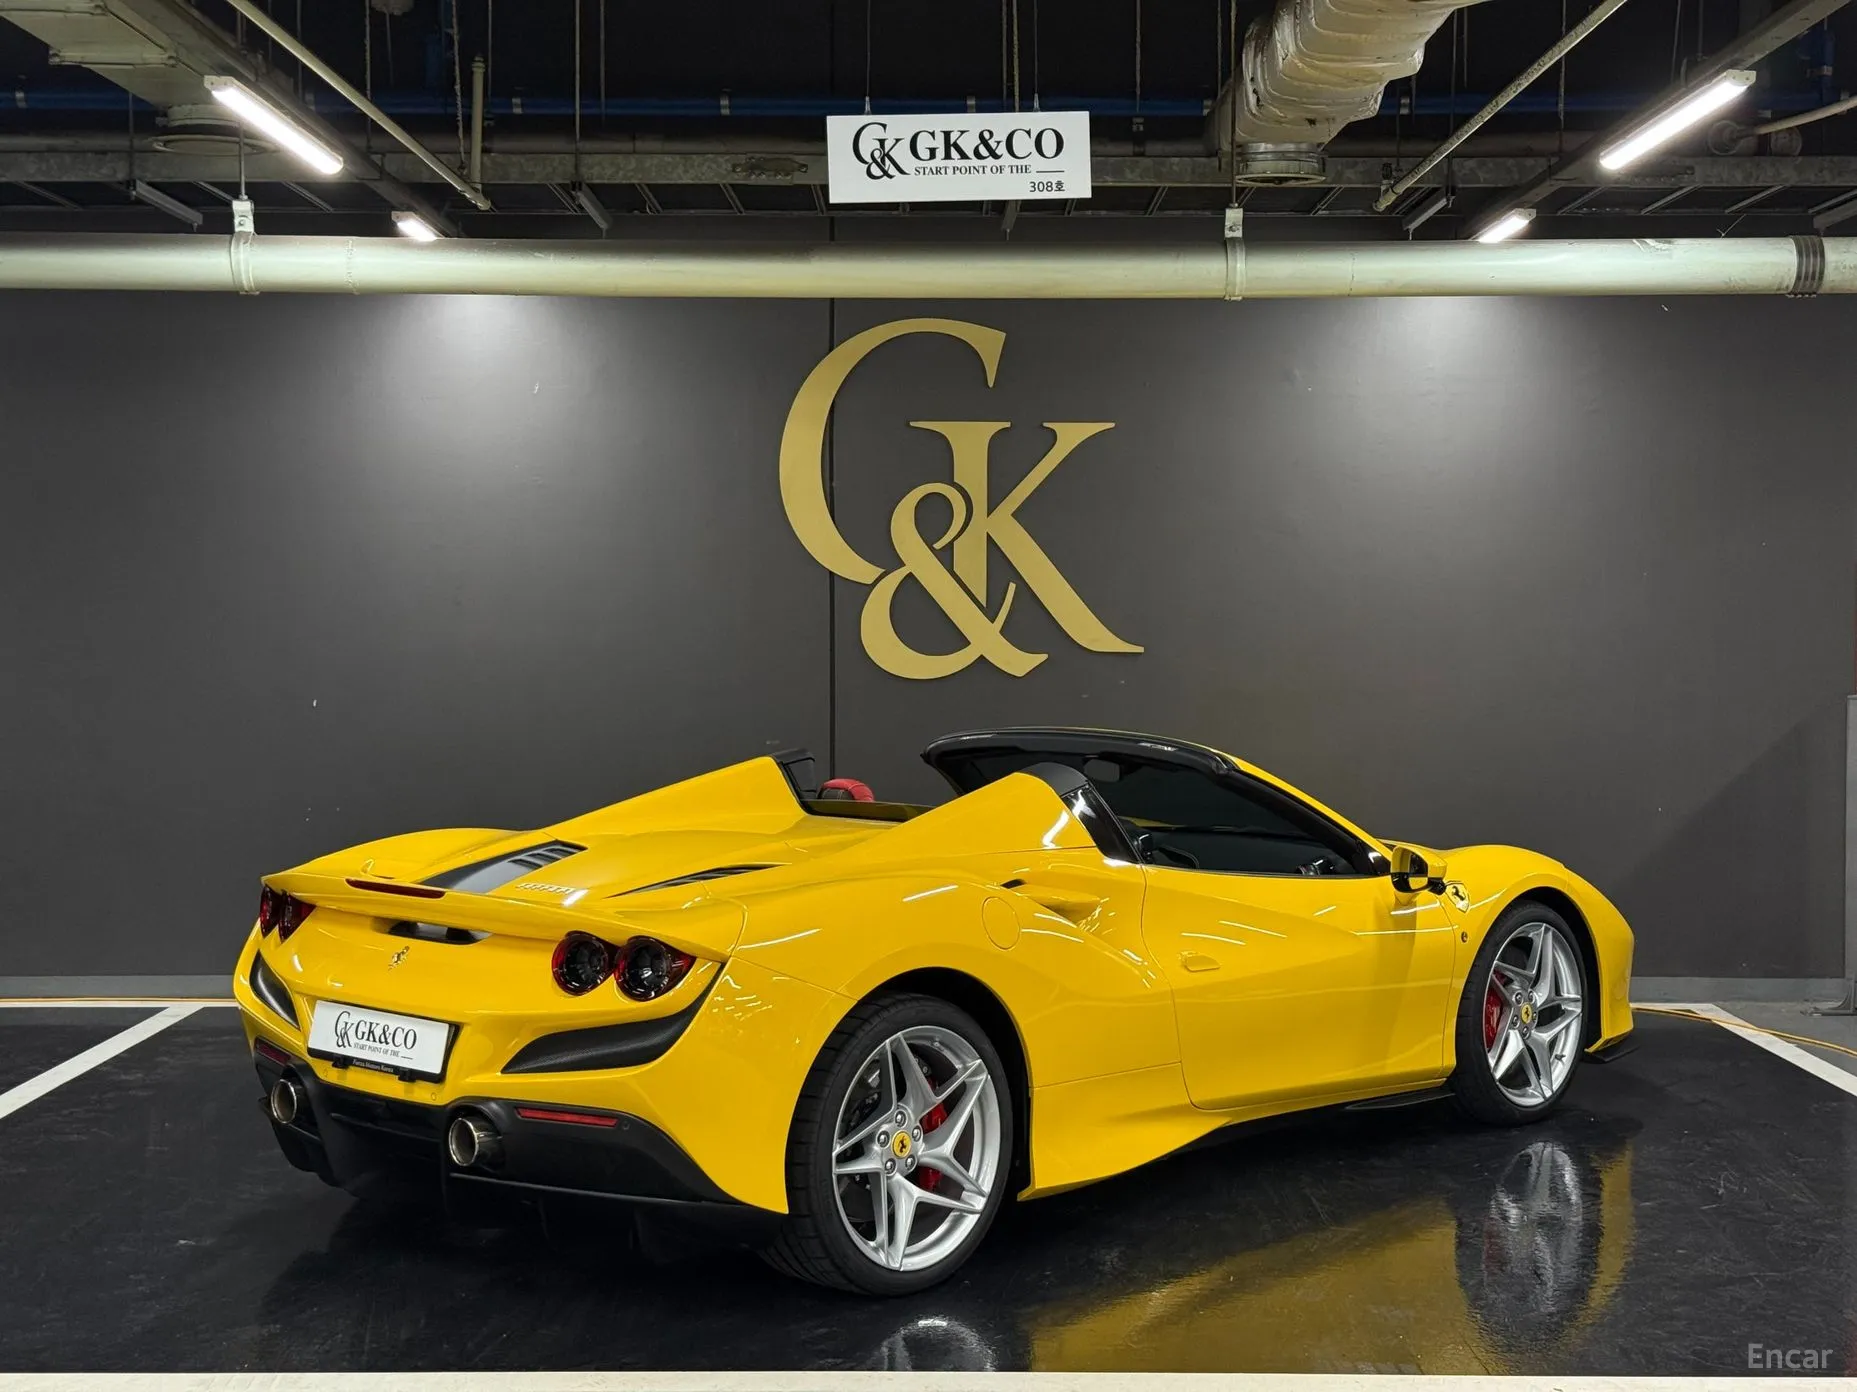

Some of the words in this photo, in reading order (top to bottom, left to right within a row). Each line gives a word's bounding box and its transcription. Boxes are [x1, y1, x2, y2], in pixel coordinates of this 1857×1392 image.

[909, 127, 1065, 162] GK&CO
[914, 166, 950, 176] START
[952, 165, 987, 175] POINT
[990, 165, 1005, 175] OF
[1008, 164, 1031, 174] THE
[1029, 180, 1065, 193] 308호
[355, 1020, 417, 1050] GK&CO
